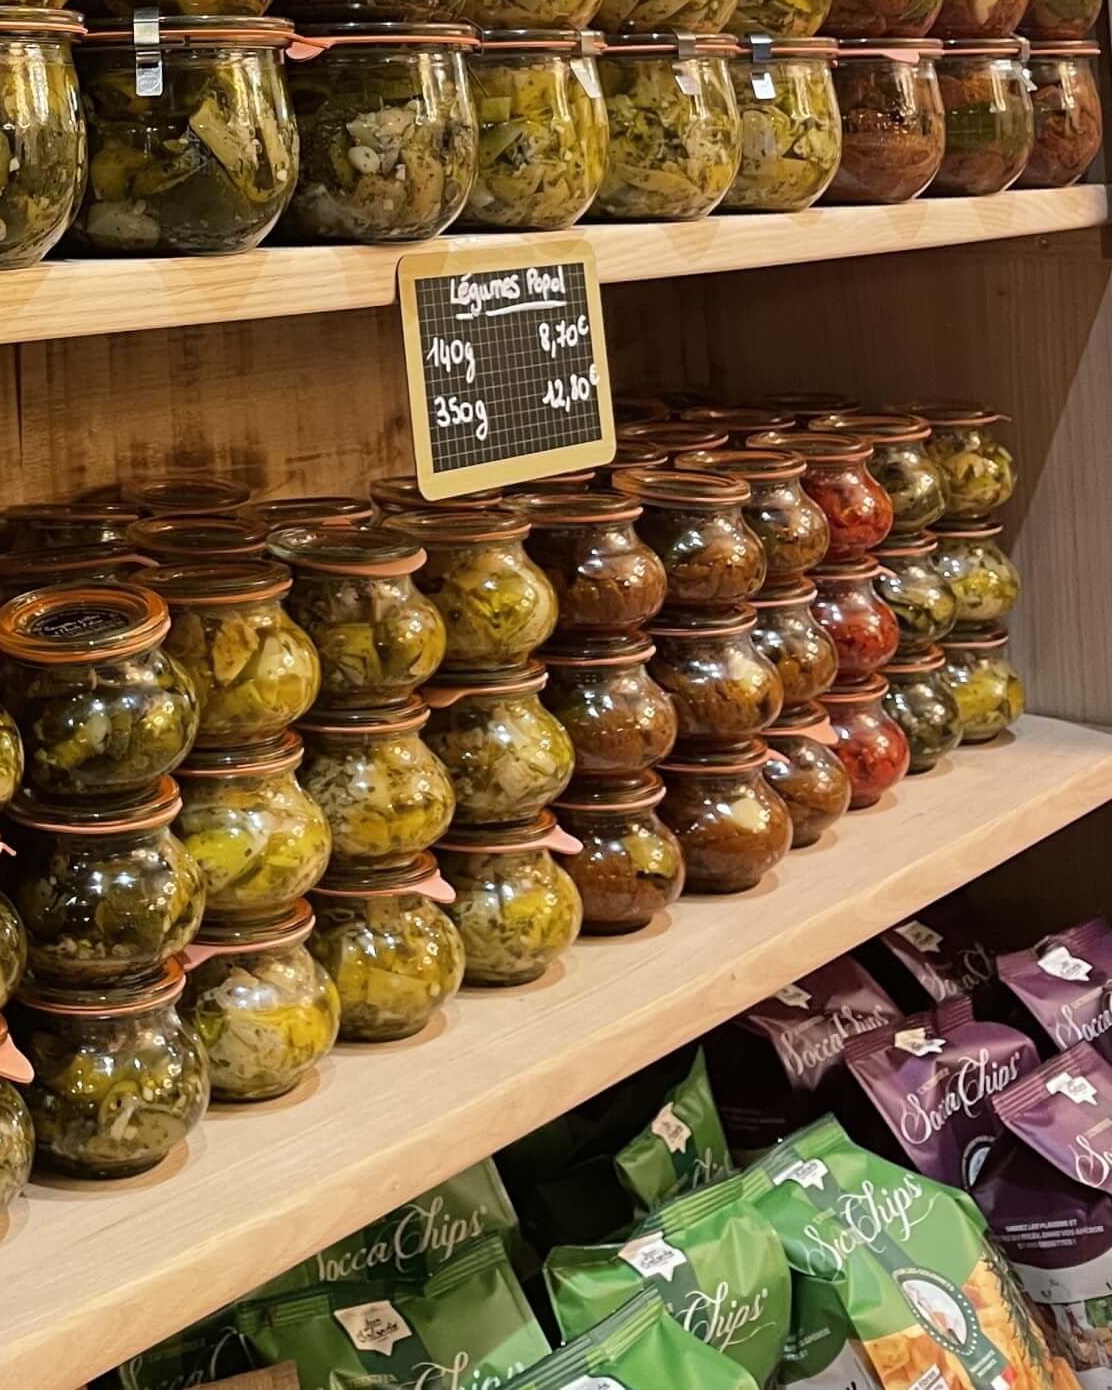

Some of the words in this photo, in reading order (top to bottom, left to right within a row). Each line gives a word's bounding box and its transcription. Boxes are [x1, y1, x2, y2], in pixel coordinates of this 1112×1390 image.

[450, 274, 520, 316] Légumes
[426, 337, 476, 383] 140g
[434, 396, 488, 441] 350g
